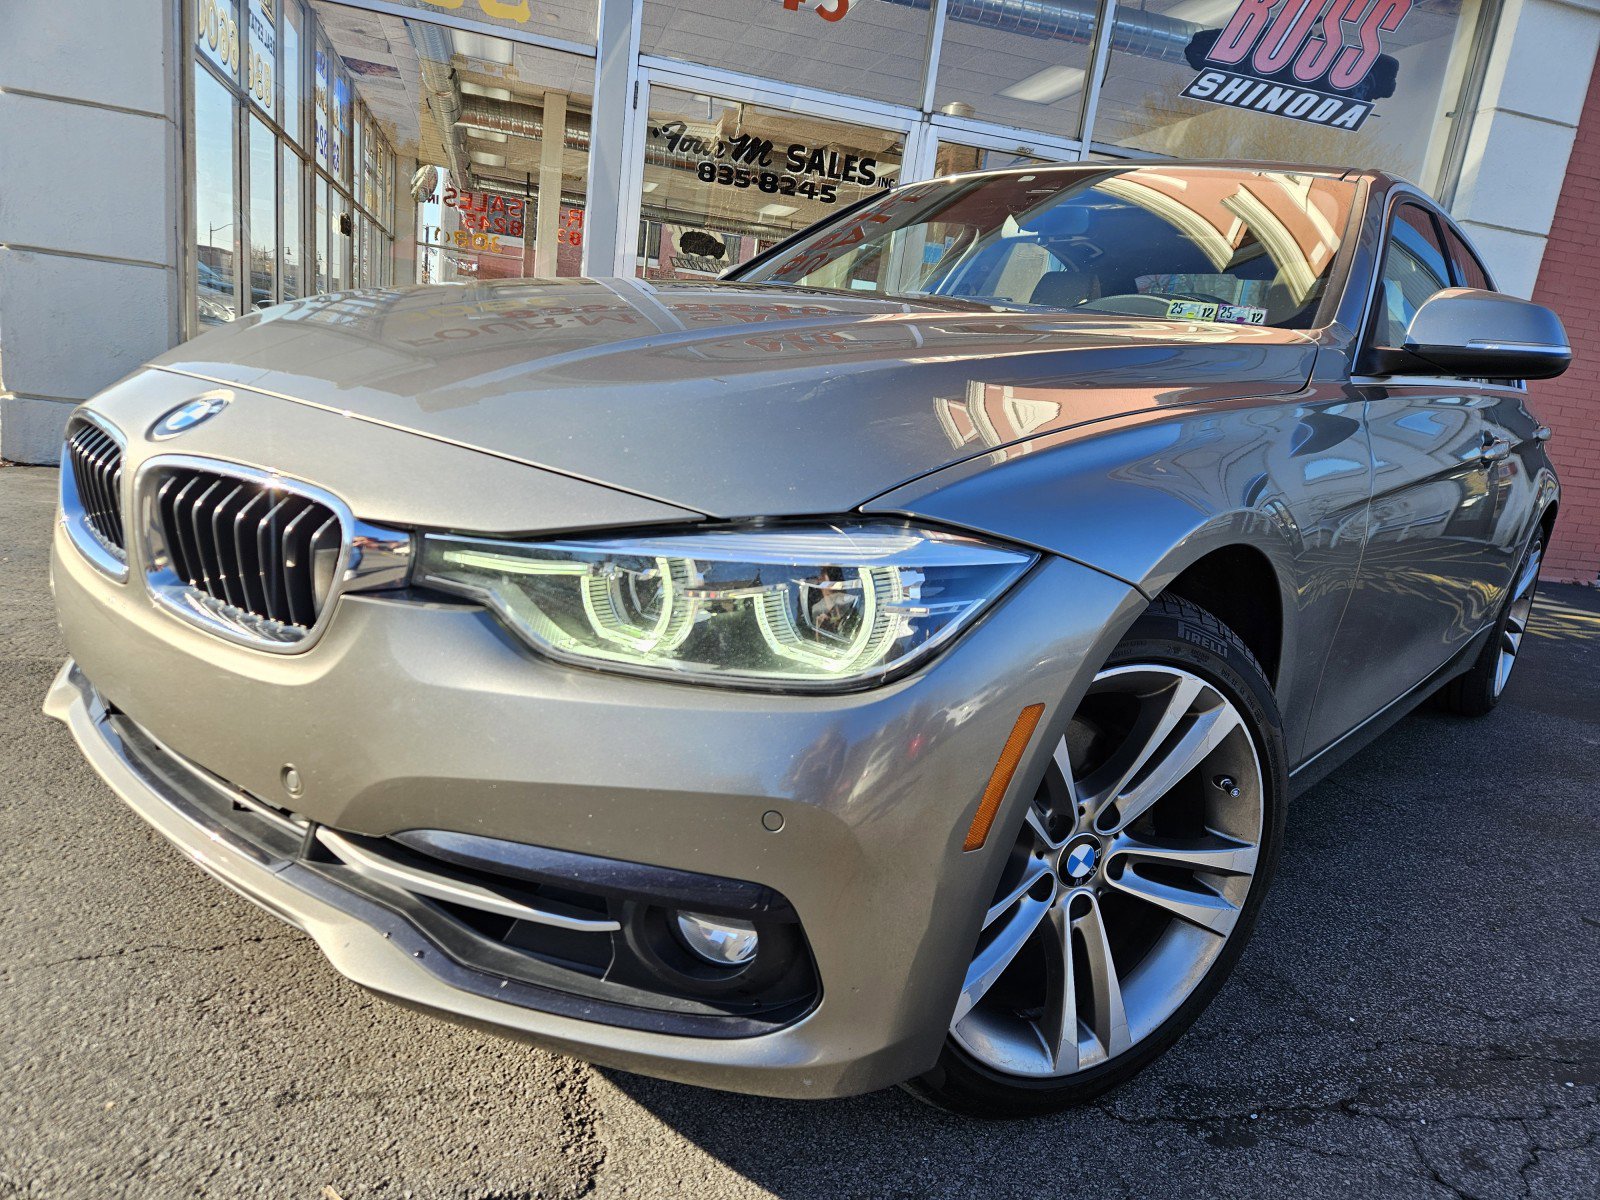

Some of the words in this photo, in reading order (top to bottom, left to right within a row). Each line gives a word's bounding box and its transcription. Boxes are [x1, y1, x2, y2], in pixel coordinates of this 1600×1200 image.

[1205, 0, 1413, 90] BOSS
[1188, 72, 1368, 130] SHINODA
[729, 133, 774, 168] M
[786, 143, 877, 187] SALES
[878, 177, 896, 189] INC
[1170, 302, 1185, 314] 25
[1201, 307, 1215, 318] 12
[1220, 306, 1234, 318] 25
[1251, 312, 1264, 323] 12
[1177, 619, 1229, 659] PIRELLI
